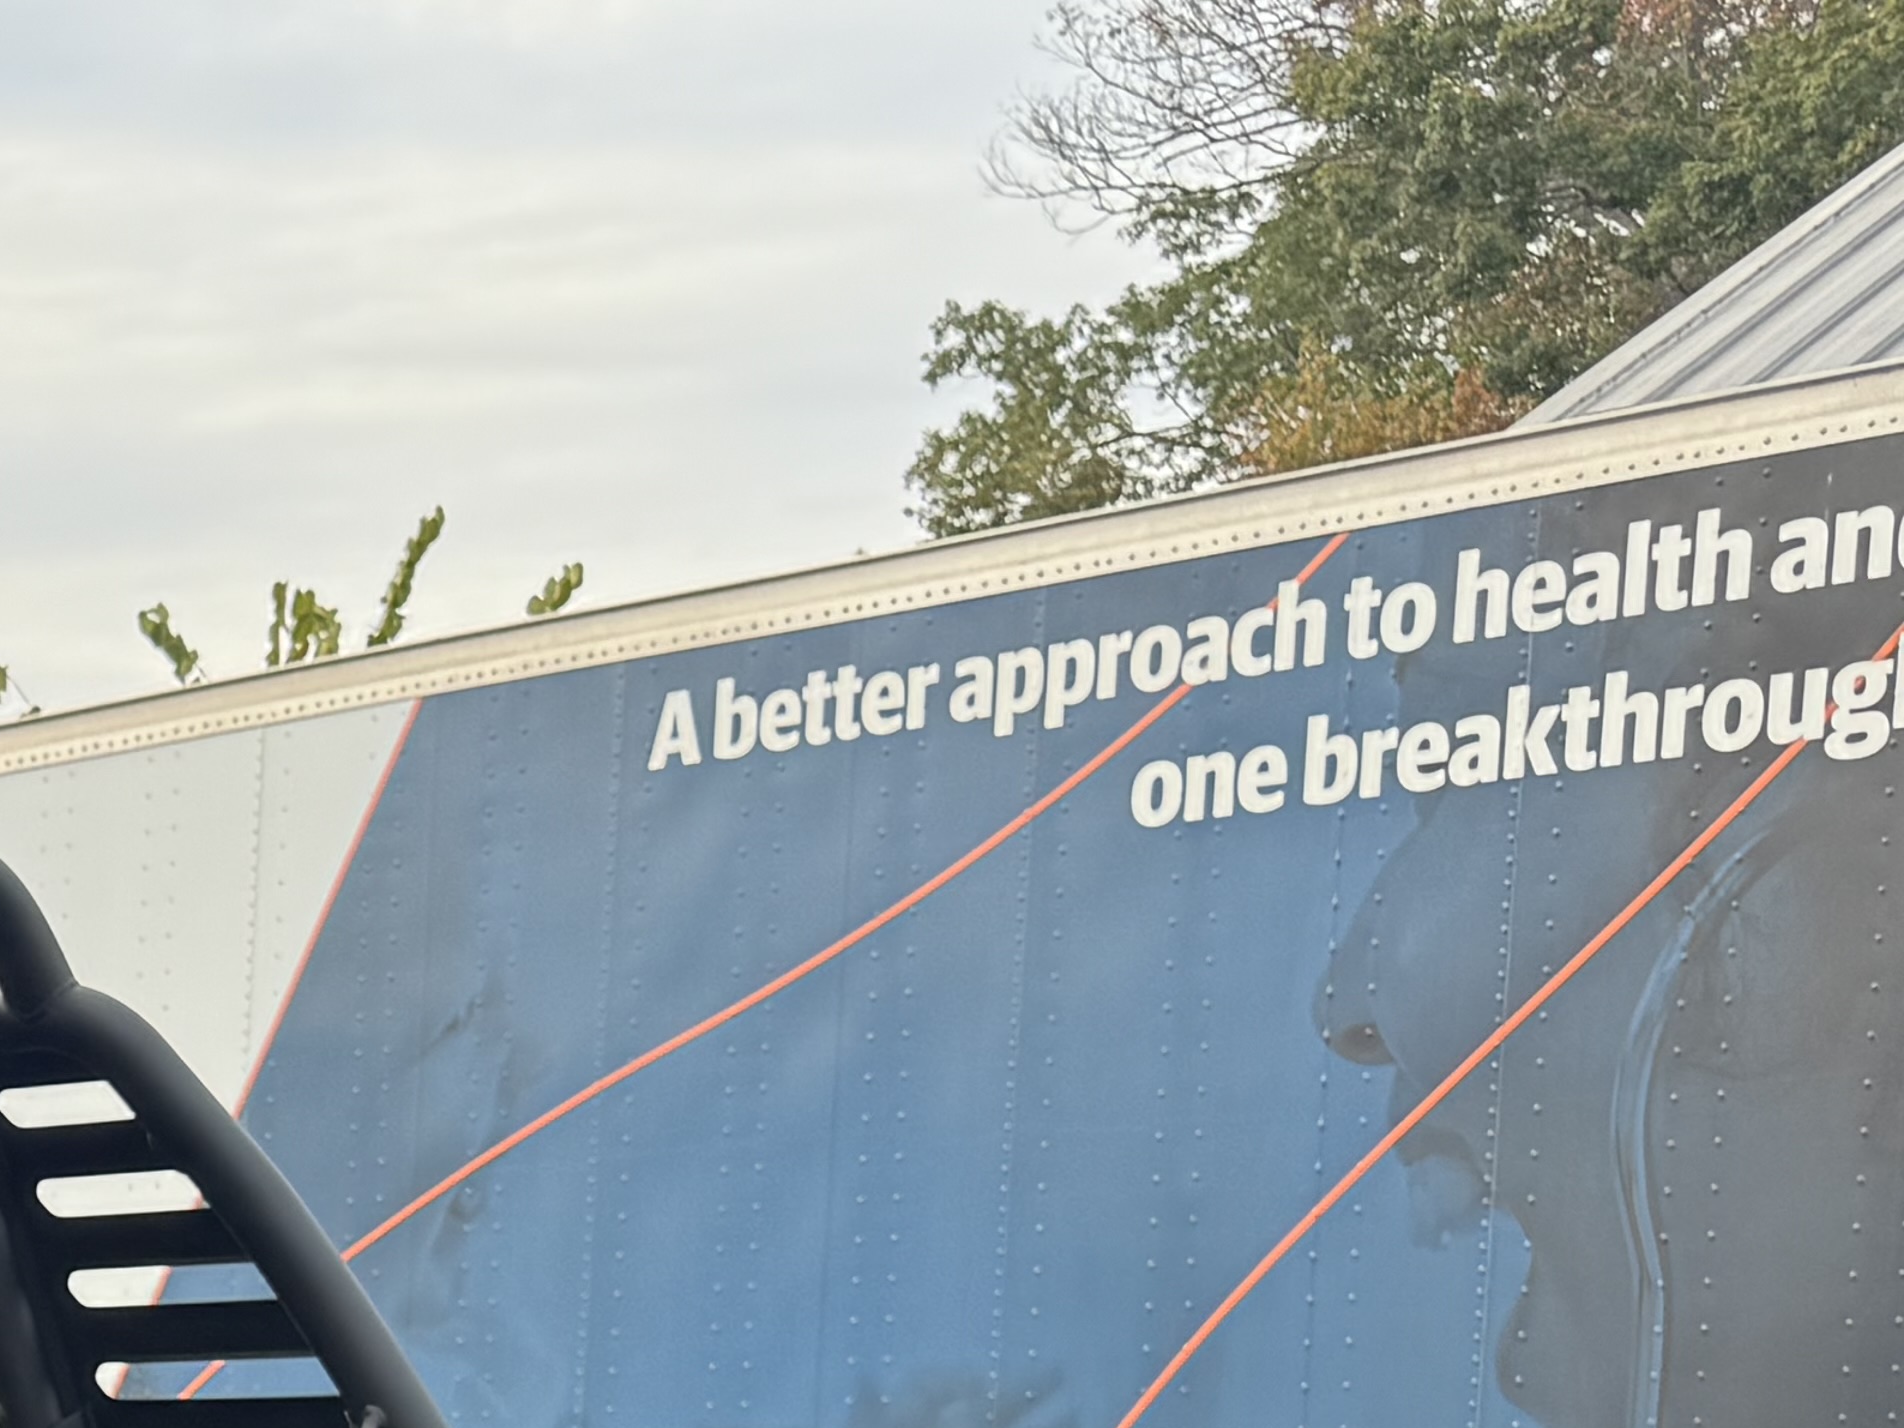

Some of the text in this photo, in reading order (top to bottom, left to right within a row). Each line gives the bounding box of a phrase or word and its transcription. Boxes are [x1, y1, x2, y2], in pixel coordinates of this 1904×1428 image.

[647, 505, 1904, 771] A better approach to health an
[1130, 630, 1904, 828] one breakthroug
